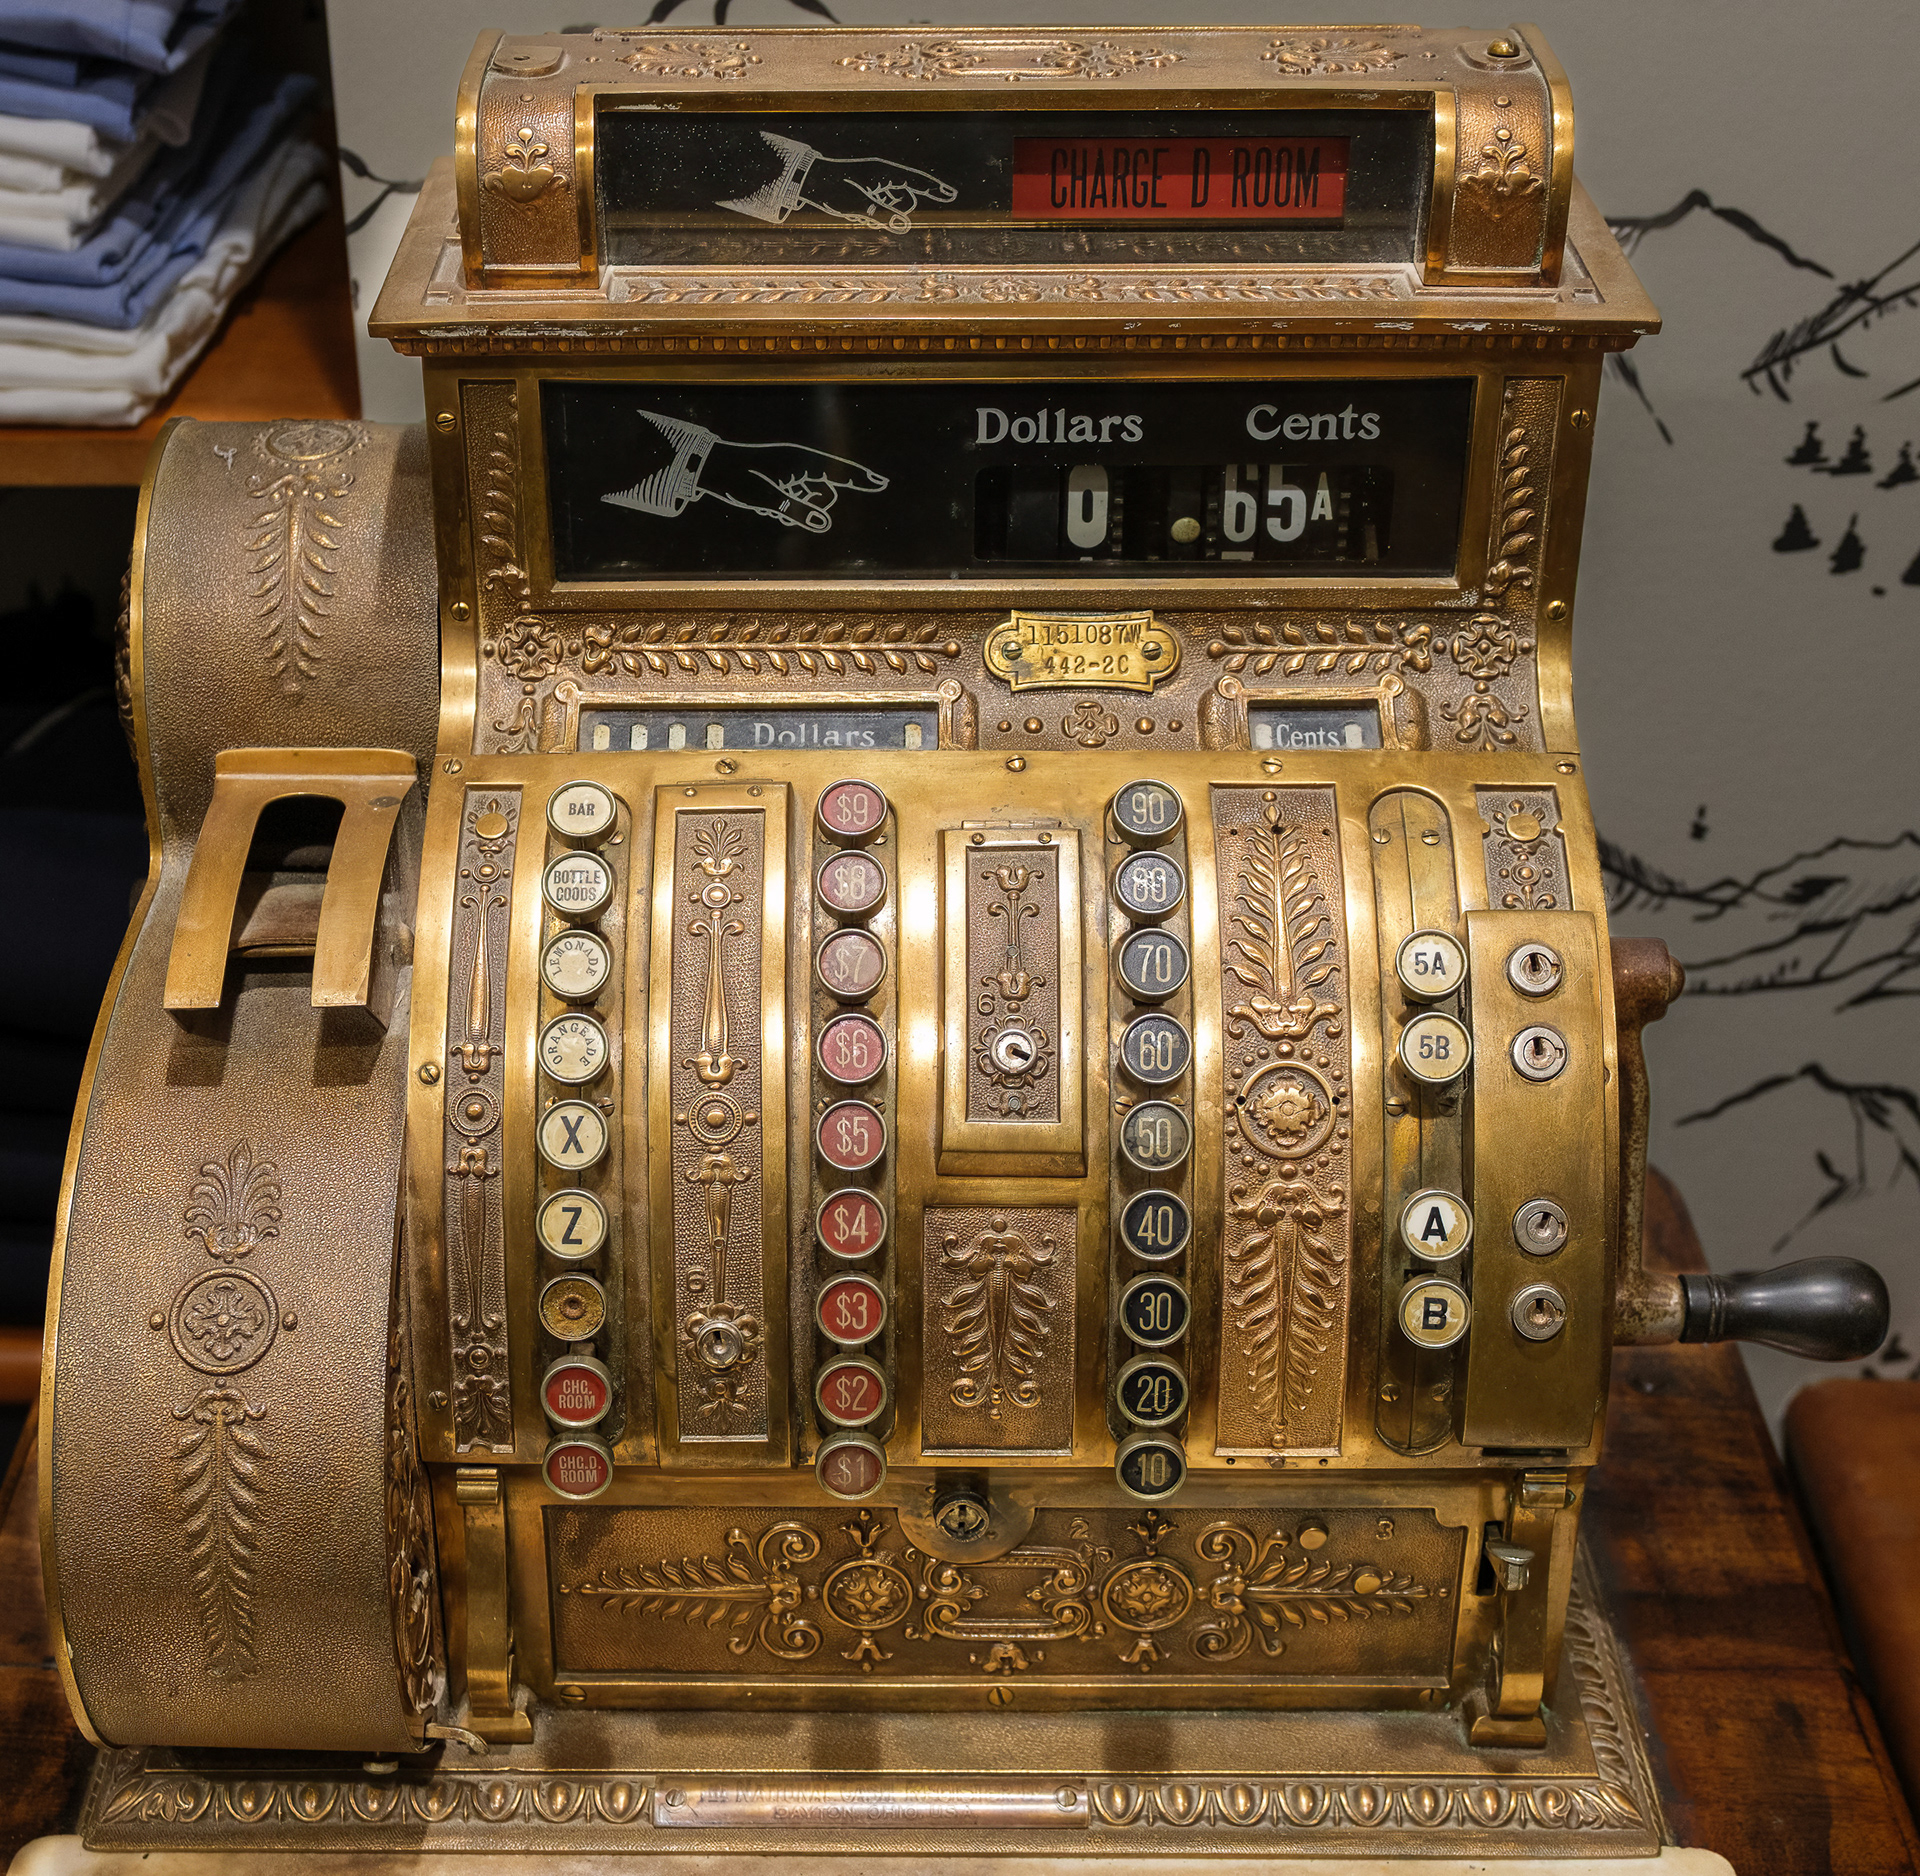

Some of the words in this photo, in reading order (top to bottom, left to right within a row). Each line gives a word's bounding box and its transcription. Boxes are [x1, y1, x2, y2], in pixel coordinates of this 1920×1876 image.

[1050, 147, 1169, 208] CHARGE
[1190, 147, 1211, 208] D
[1231, 146, 1321, 208] ROOM
[975, 407, 1144, 444] Dollars
[1246, 403, 1382, 441] Cents
[1044, 654, 1130, 675] 442-2C
[753, 722, 876, 748] Dollars
[1276, 723, 1341, 749] Cents
[568, 802, 596, 816] BAR
[837, 793, 868, 825] $9
[1131, 792, 1165, 825] 90
[553, 870, 601, 885] BOTTLE
[556, 886, 597, 901] GOODS
[834, 865, 866, 900] $8
[1133, 867, 1167, 903] 80
[549, 940, 599, 977] LEMONADE
[834, 944, 869, 983] $7
[1137, 944, 1172, 983] 70
[1414, 951, 1447, 976] 5A
[548, 1022, 597, 1067] ORANGEADE
[835, 1029, 868, 1069] $6
[1139, 1030, 1173, 1072] 60
[1418, 1035, 1450, 1060] 5B
[560, 1115, 585, 1154] X
[836, 1116, 869, 1157] $5
[1138, 1117, 1172, 1158] 50
[561, 1206, 583, 1245] Z
[833, 1204, 869, 1244] $4
[1137, 1205, 1173, 1246] 40
[1421, 1206, 1448, 1242] A
[836, 1292, 868, 1330] $3
[1139, 1292, 1172, 1331] 30
[1422, 1297, 1449, 1330] B
[558, 1394, 596, 1409] ROOM
[562, 1379, 593, 1394] CHG.
[835, 1375, 869, 1411] $2
[1136, 1375, 1171, 1412] 20
[560, 1469, 598, 1483] ROOM
[837, 1453, 865, 1488] $1
[1137, 1453, 1166, 1487] 10
[1375, 1517, 1394, 1541] 3
